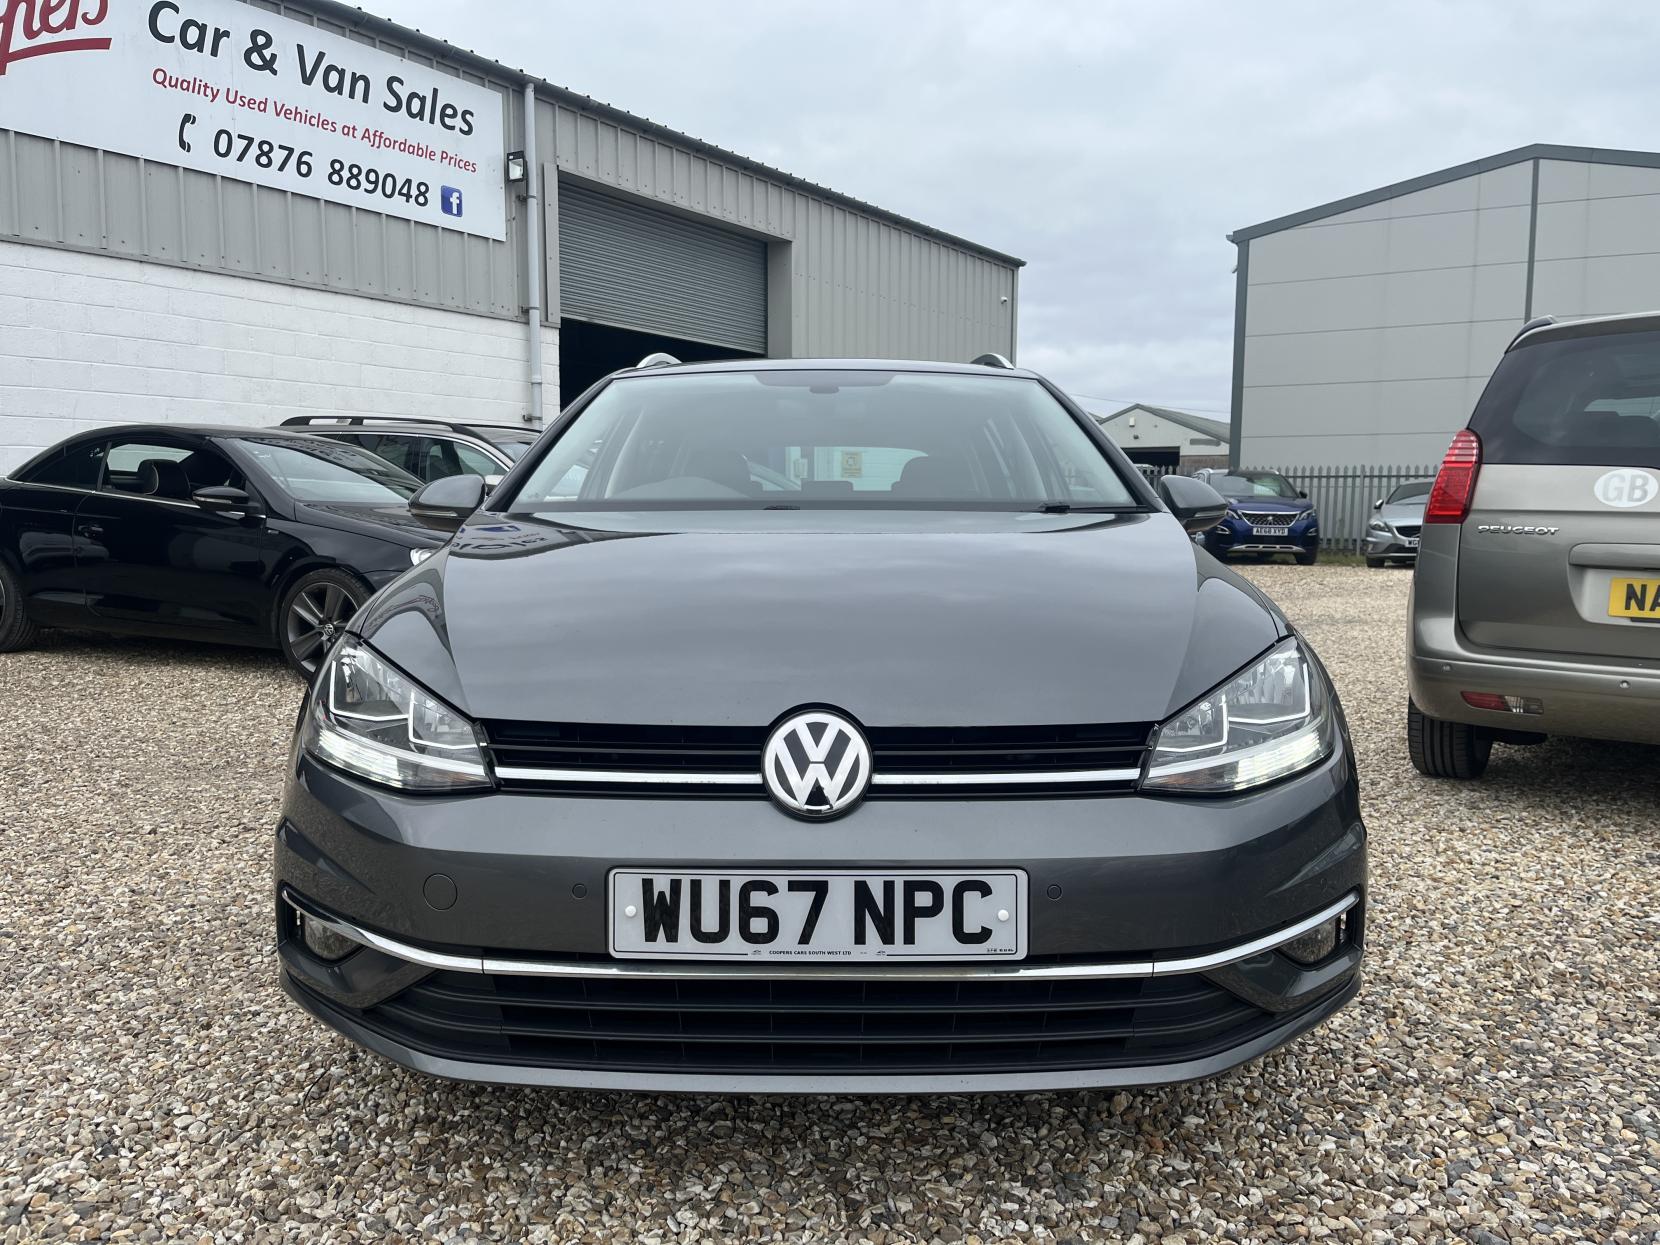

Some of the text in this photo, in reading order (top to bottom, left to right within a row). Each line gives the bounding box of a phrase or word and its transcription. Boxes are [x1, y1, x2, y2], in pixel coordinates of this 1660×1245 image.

[148, 0, 474, 136] Car & Van Sales
[152, 68, 477, 173] Quality Used Vehicles at Affordable Prices
[213, 129, 430, 207] 07876 889048
[1602, 473, 1650, 502] GB
[1478, 525, 1560, 536] PEUGEOT
[641, 877, 994, 946] WU67 NPC
